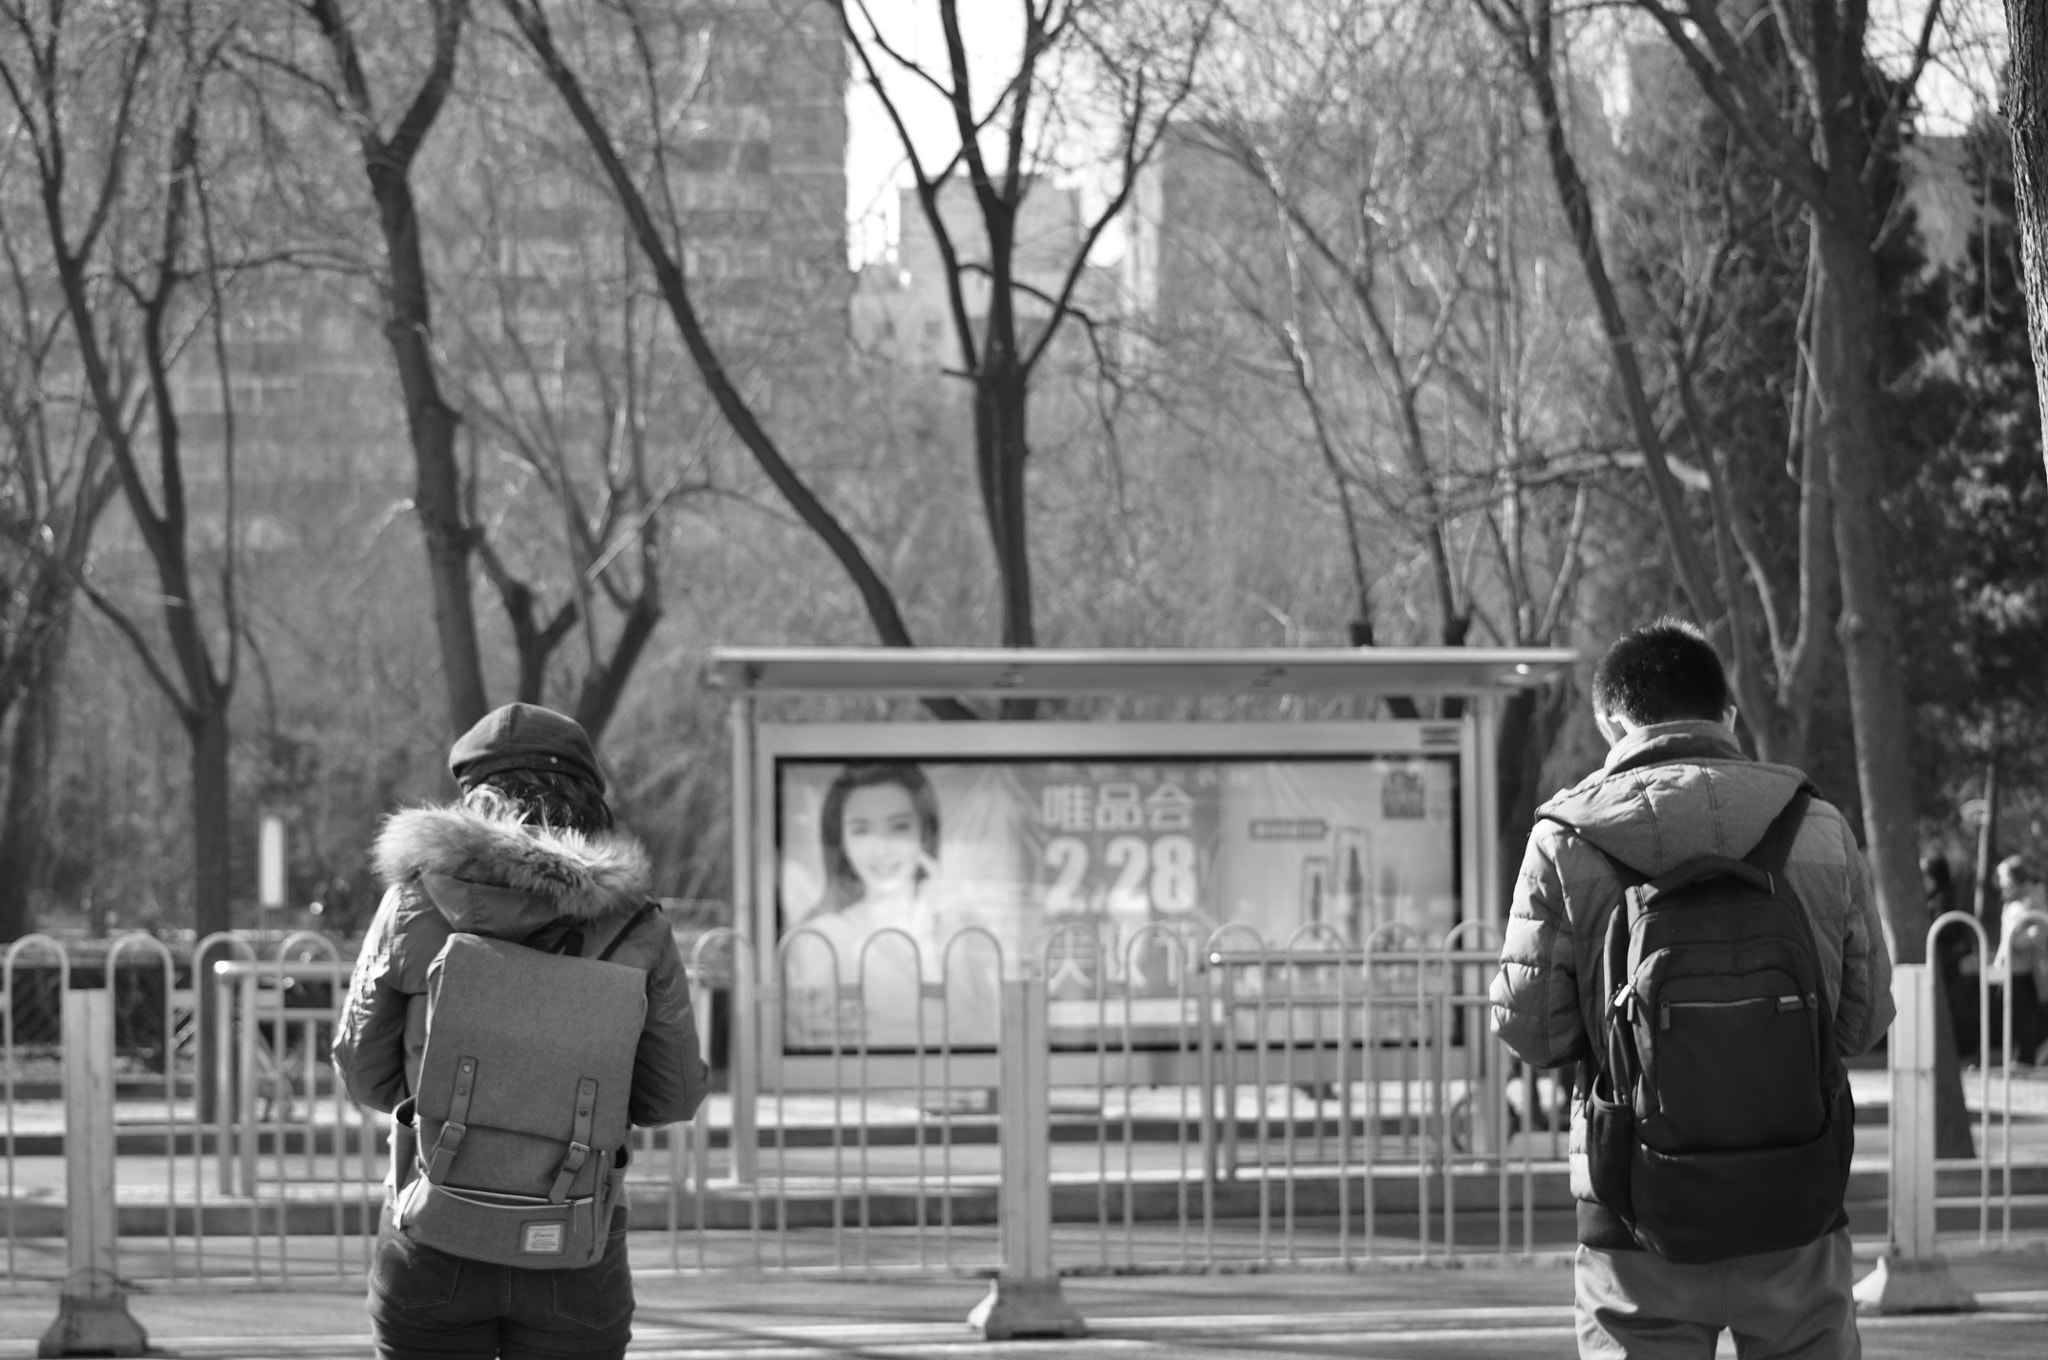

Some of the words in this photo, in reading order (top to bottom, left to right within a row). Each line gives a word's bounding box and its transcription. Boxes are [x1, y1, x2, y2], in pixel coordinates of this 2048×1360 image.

[1042, 782, 1194, 832] 唯品会
[1046, 835, 1196, 914] 2.28
